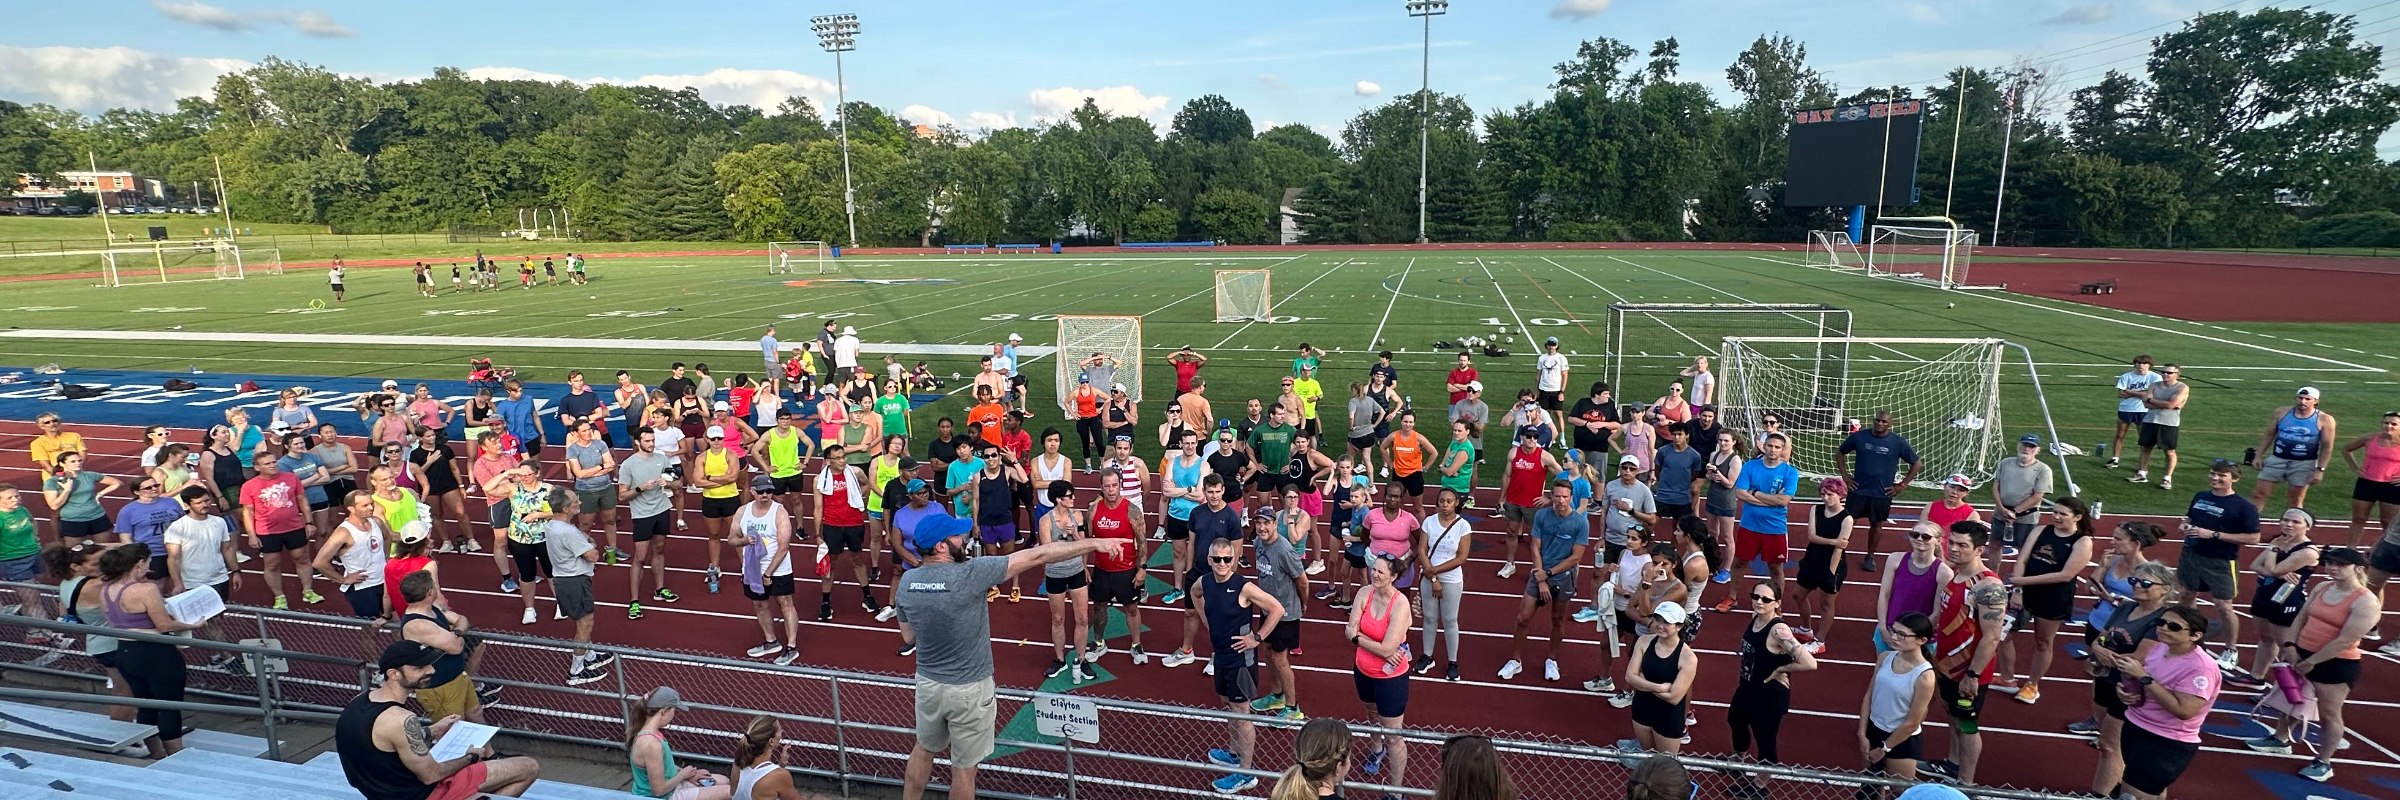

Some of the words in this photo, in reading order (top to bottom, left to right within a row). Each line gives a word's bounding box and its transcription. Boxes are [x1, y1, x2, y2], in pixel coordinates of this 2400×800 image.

[1796, 109, 1835, 124] GAY
[1868, 101, 1921, 118] FIELD
[1479, 317, 1569, 326] 10
[909, 582, 947, 590] SPEEDWORK
[1050, 698, 1081, 711] Clayton
[1036, 709, 1067, 722] Student
[1069, 714, 1098, 726] Section
